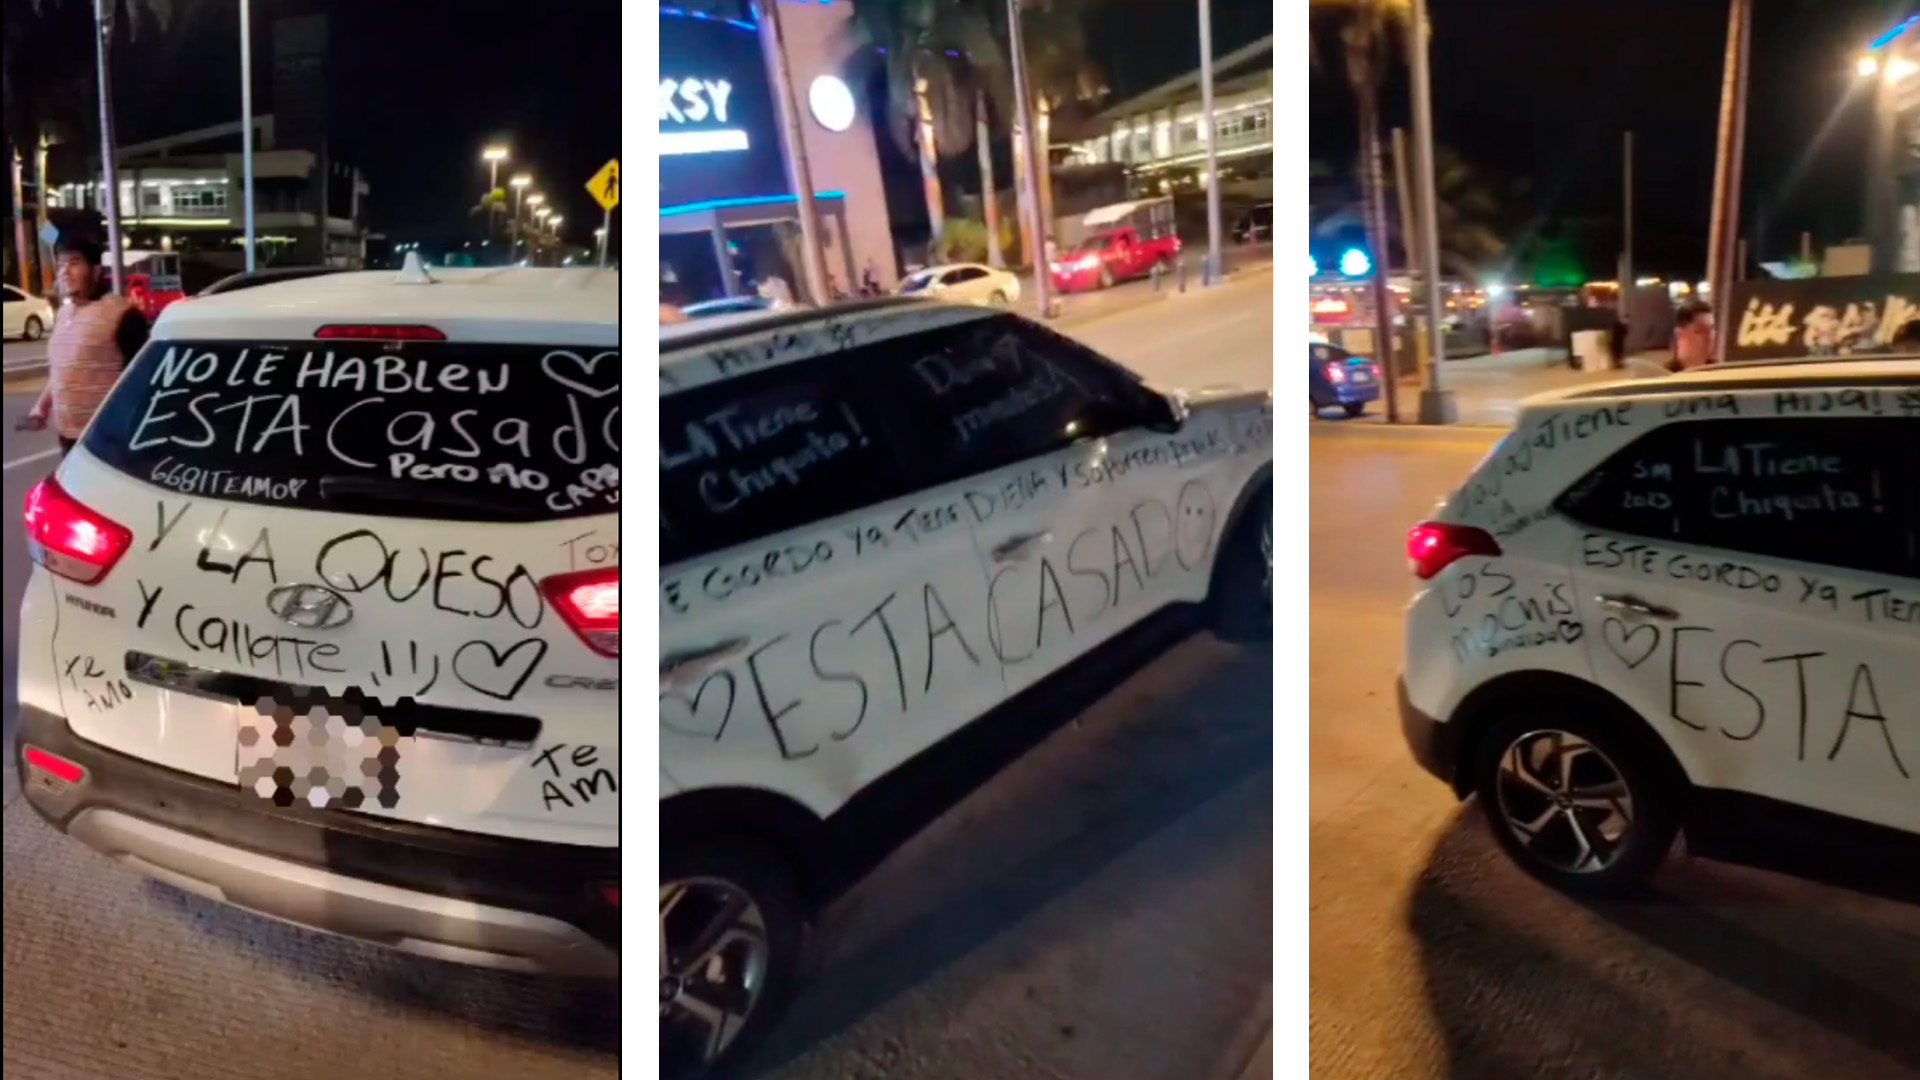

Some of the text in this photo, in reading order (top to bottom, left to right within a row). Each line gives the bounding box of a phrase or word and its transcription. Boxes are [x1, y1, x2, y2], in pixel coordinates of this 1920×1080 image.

[151, 347, 216, 388] NO
[230, 348, 285, 388] LE
[129, 389, 310, 455] ESTA
[151, 500, 546, 629] Y LA QUESO
[1584, 534, 1659, 574] ESTE
[1667, 555, 1781, 594] GORDO
[137, 578, 163, 629] Y
[746, 580, 980, 761] ESTA
[1669, 626, 1911, 780] ESTA
